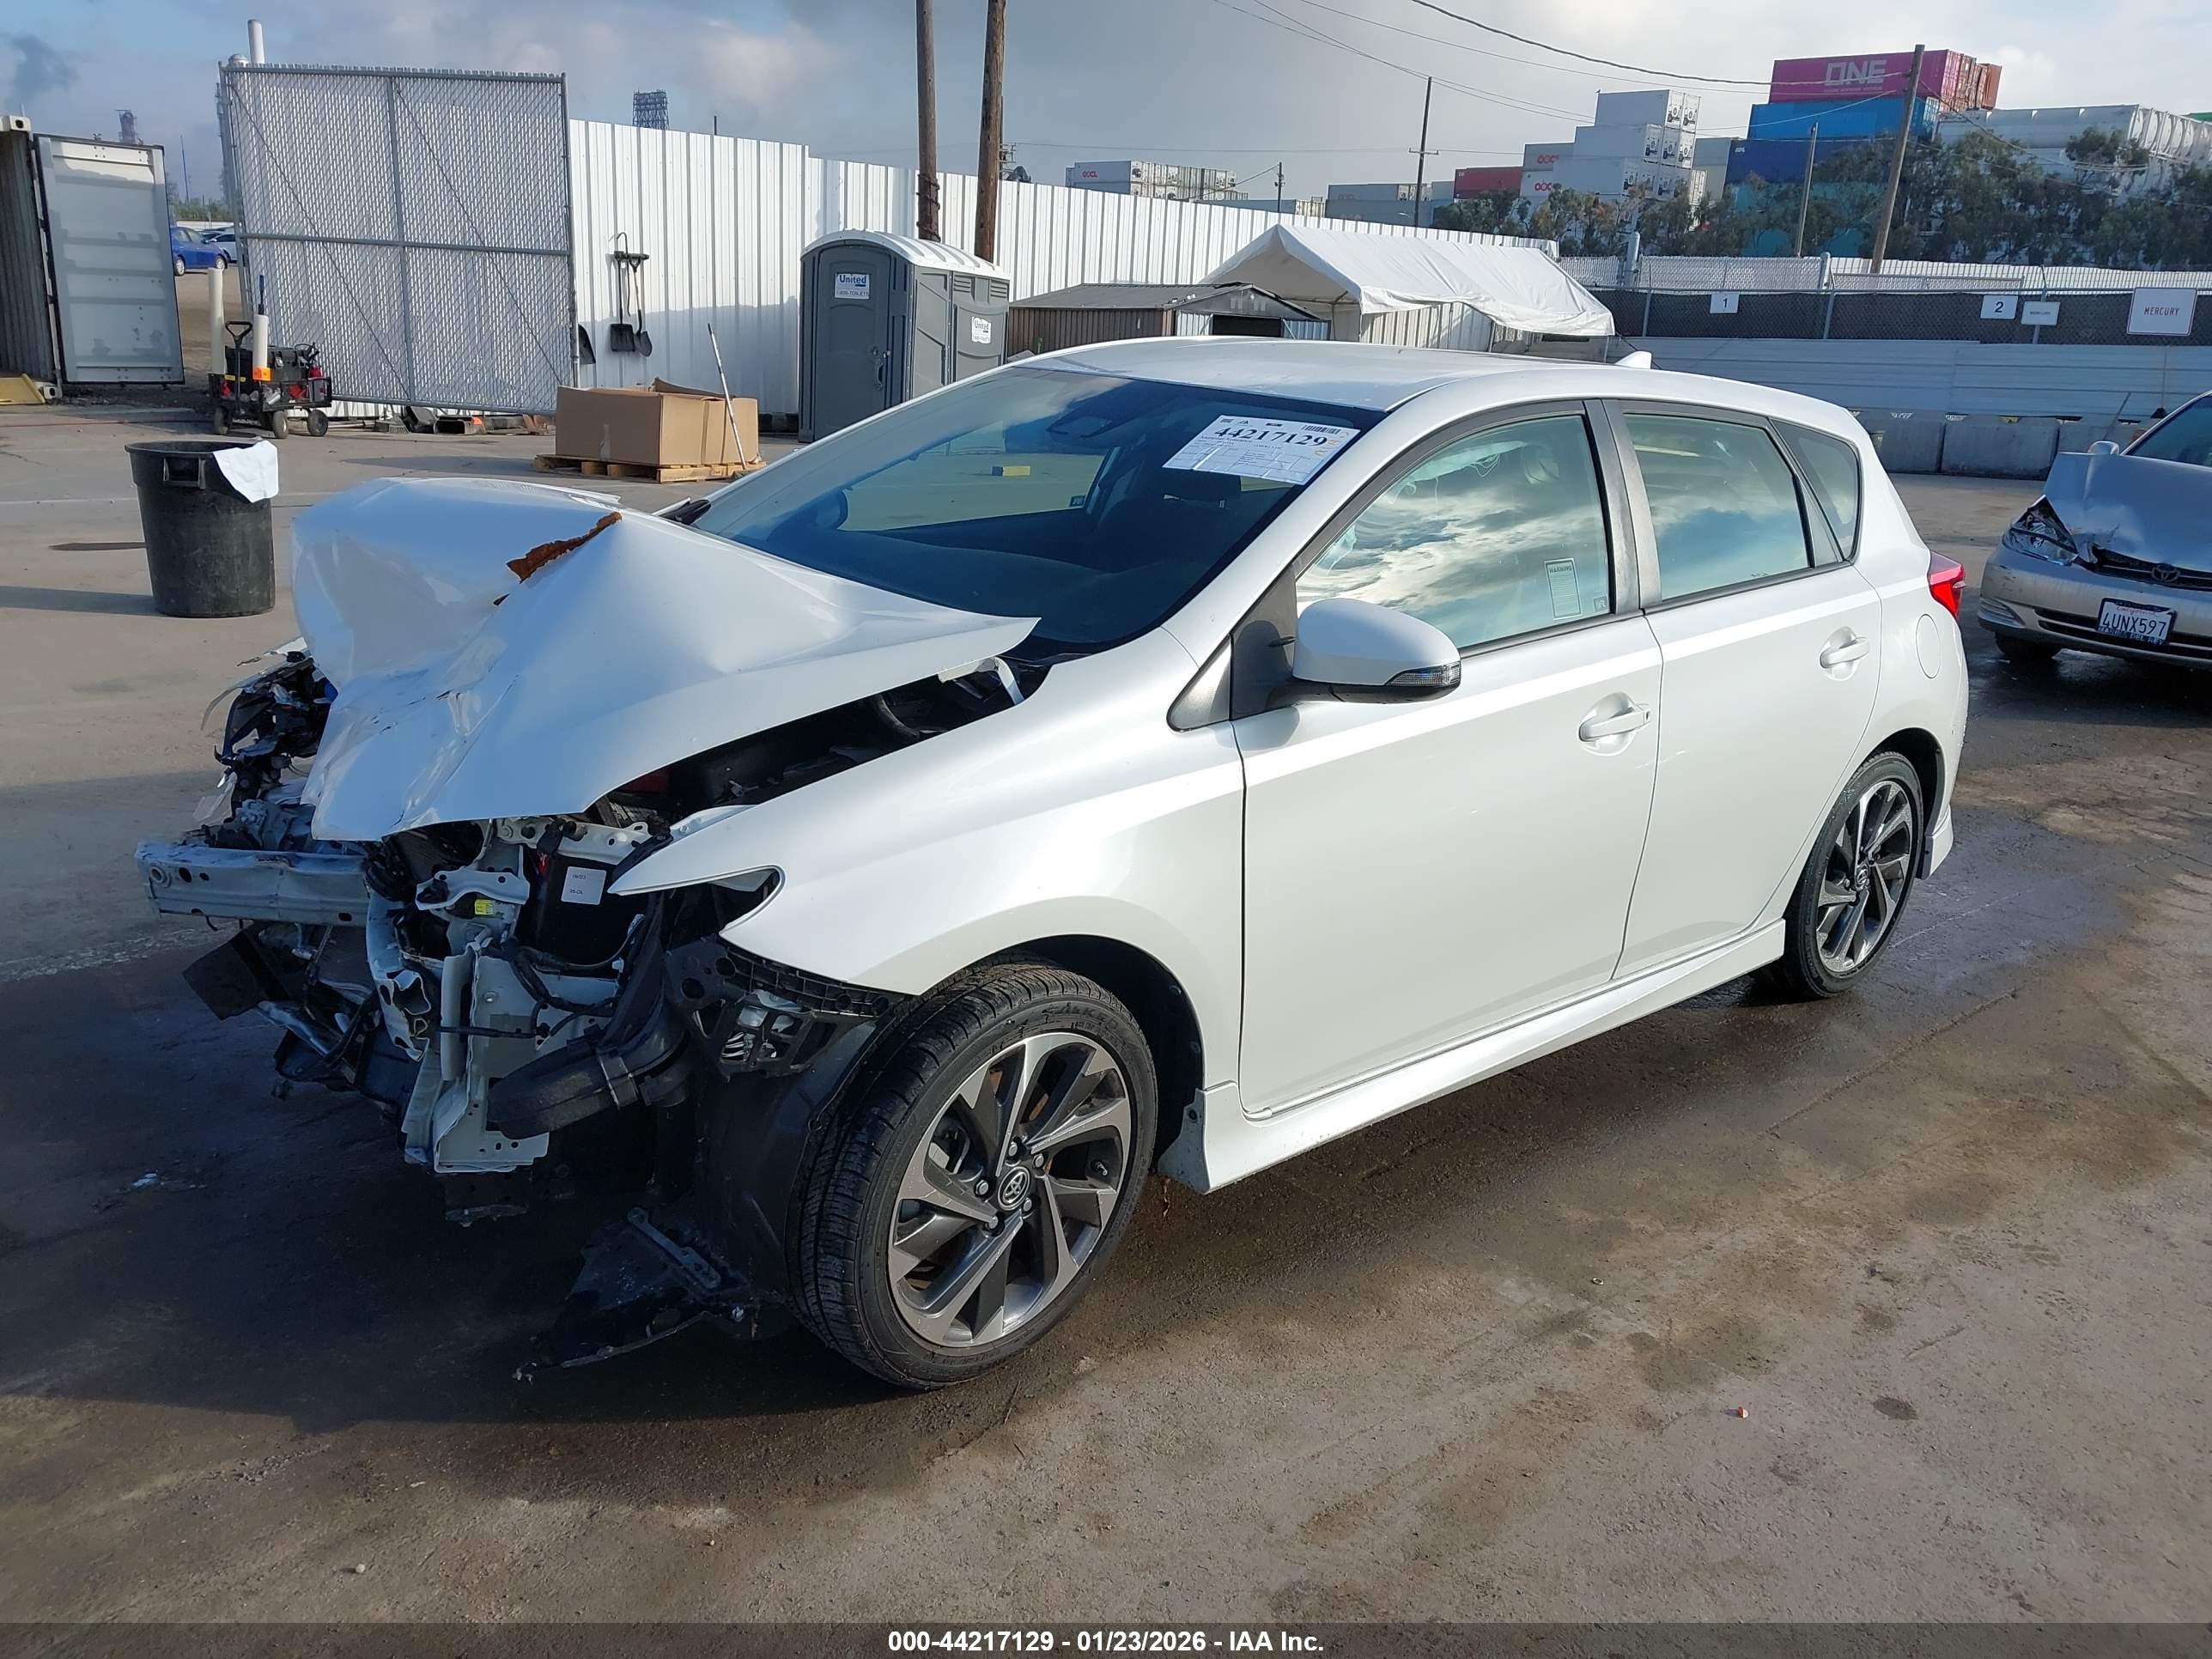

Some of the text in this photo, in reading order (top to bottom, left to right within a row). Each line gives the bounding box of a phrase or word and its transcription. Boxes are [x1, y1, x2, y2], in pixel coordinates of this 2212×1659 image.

[1826, 60, 1887, 86] ONE
[839, 274, 866, 283] United
[1723, 297, 1728, 308] 1
[1994, 301, 2004, 313] 2
[2144, 306, 2179, 317] MERCURY
[1214, 427, 1328, 447] 44217129
[2102, 611, 2166, 637] 4UNX597
